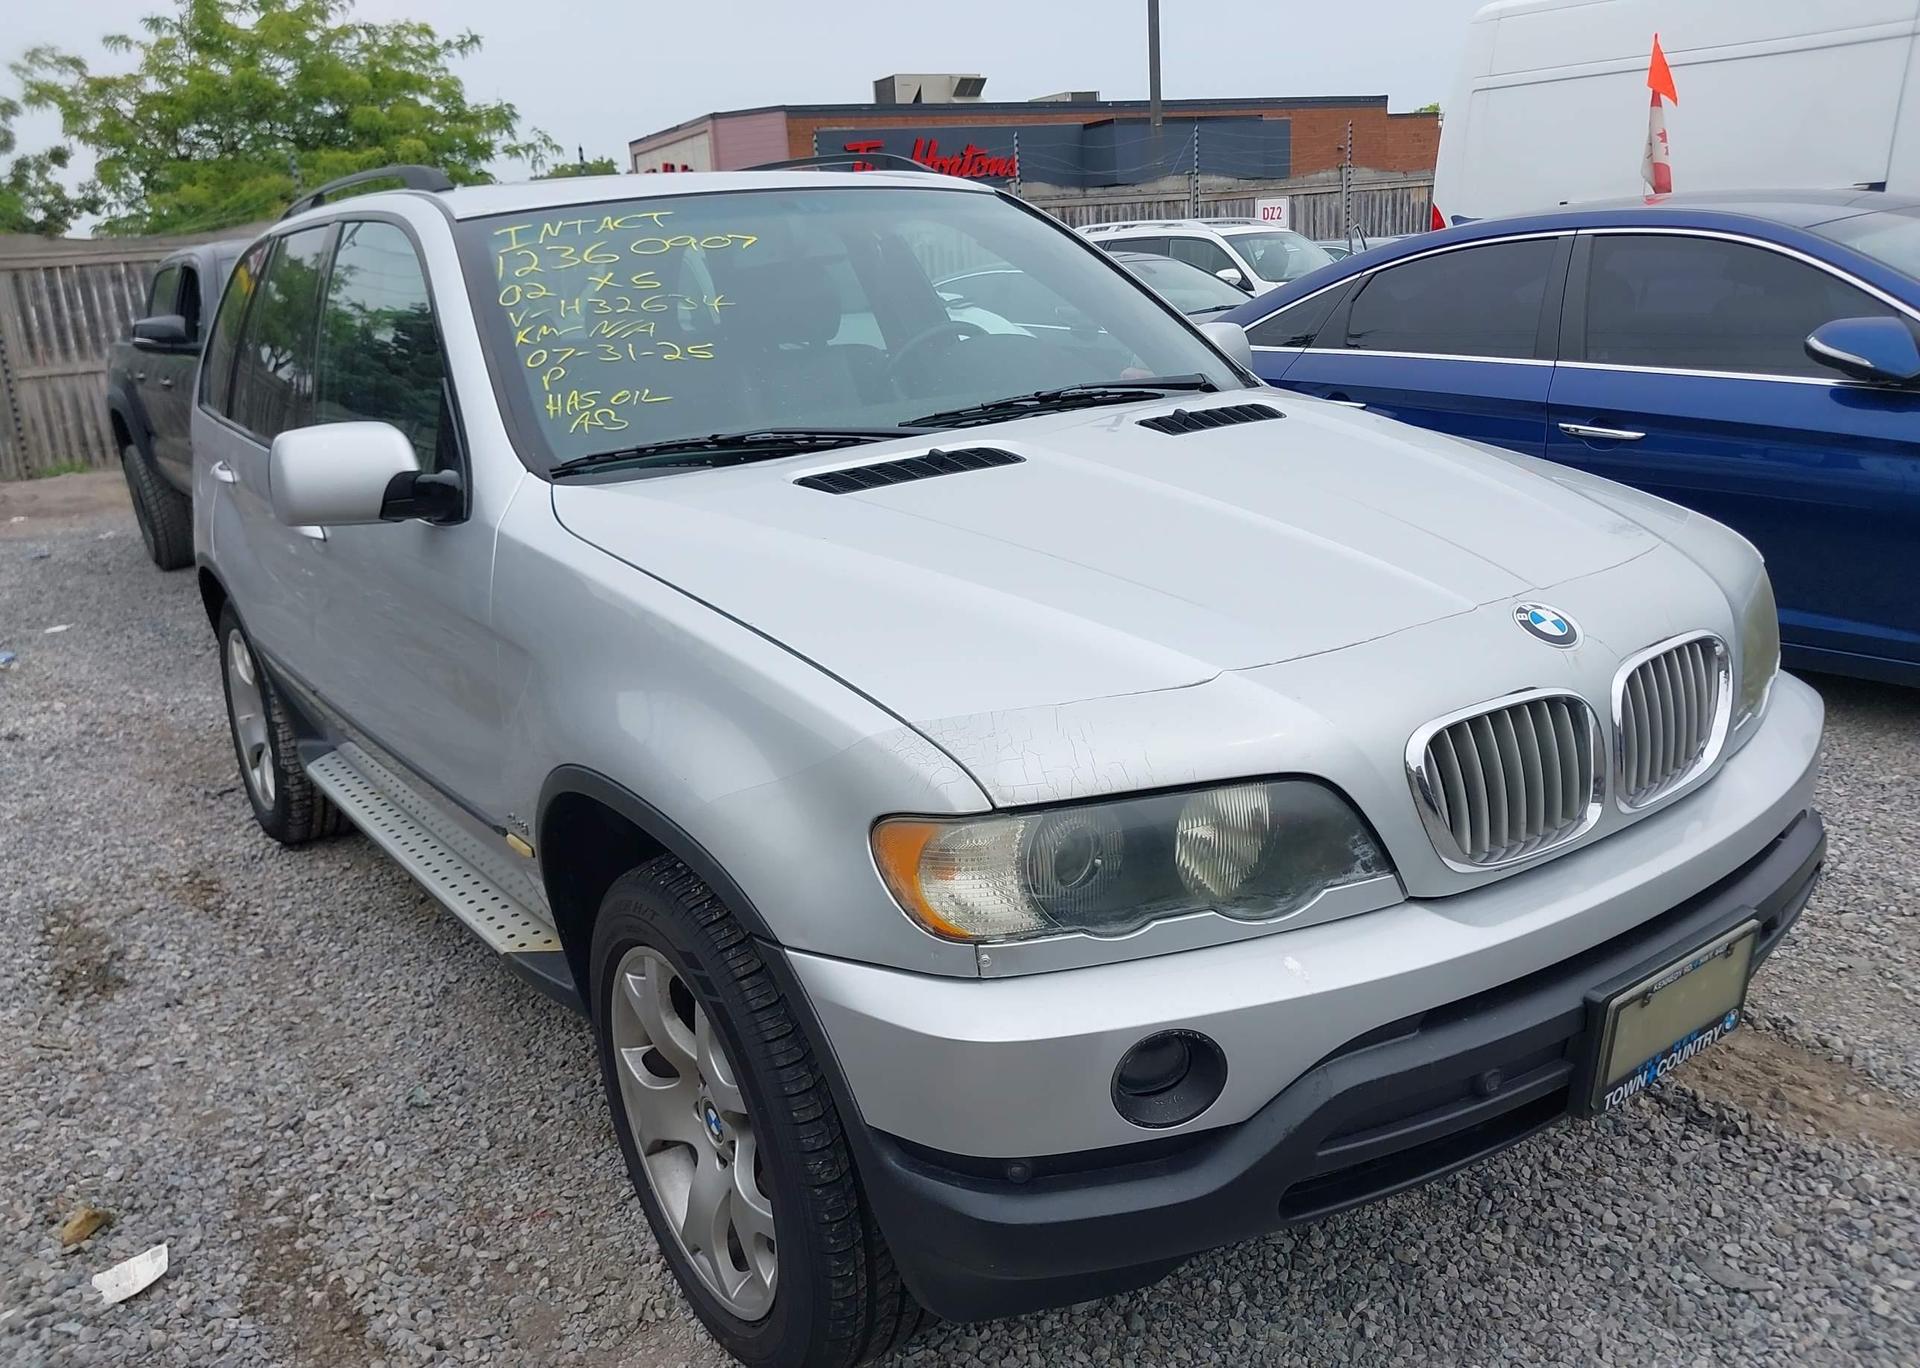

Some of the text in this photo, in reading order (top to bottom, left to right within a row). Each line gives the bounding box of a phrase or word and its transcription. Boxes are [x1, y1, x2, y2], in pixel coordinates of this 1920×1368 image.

[1262, 206, 1282, 220] DZ2
[494, 211, 675, 253] INTACT
[527, 341, 714, 367] 07-31-25
[546, 388, 674, 419] HAS OIL
[1604, 1070, 1648, 1111] TOWN
[1656, 1023, 1723, 1077] COUNTRY
